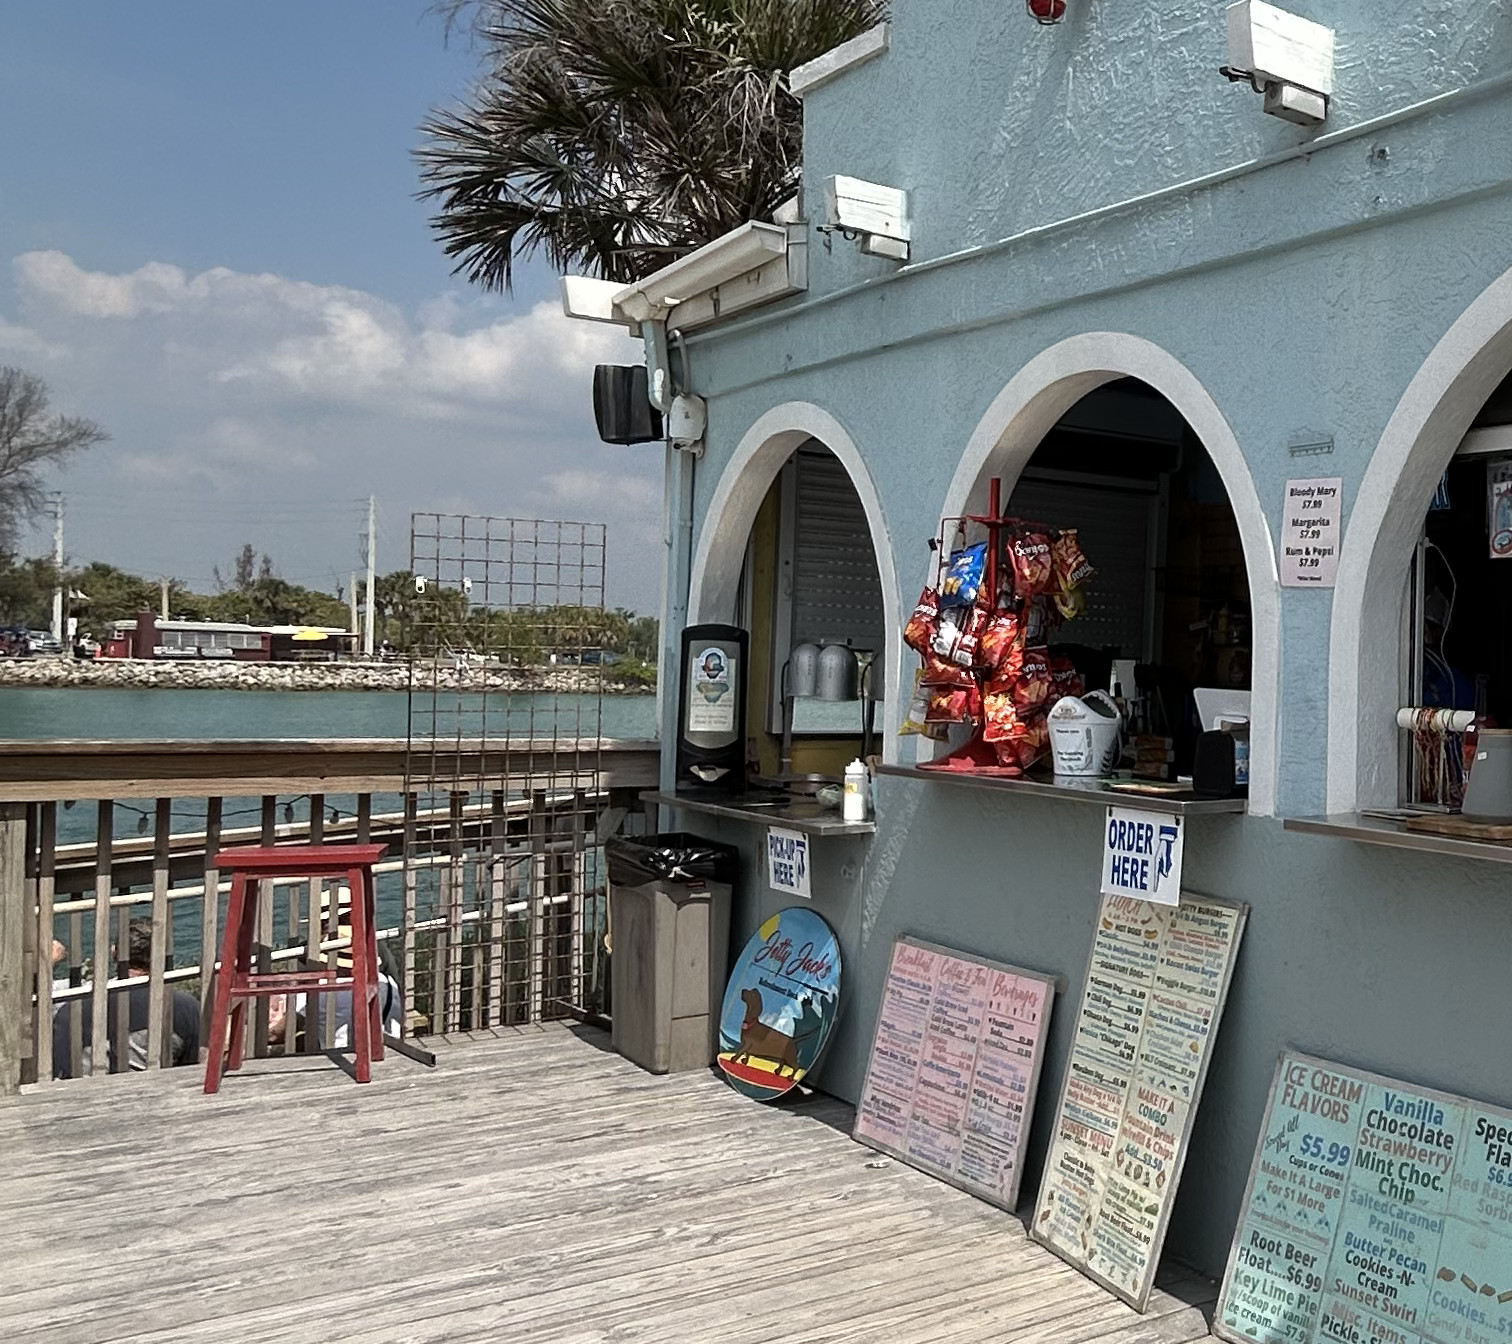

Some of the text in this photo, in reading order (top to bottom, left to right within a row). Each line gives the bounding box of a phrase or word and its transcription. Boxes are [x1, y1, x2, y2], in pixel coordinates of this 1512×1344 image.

[1290, 487, 1336, 498] Bloody Mary
[1302, 500, 1322, 509] $7.99
[1291, 517, 1330, 528] Margarita
[1300, 529, 1320, 539] $7.99
[1286, 546, 1334, 557] Rum & Pepsi
[1299, 558, 1319, 567] $7.99
[1108, 819, 1154, 855] ORDER
[774, 862, 795, 887] HERE
[1110, 854, 1149, 891] HERE
[754, 930, 832, 982] Jetty Jack's
[1284, 1061, 1363, 1104] ICE CREAM
[1137, 1087, 1175, 1114] MAKE IT A
[1138, 1103, 1167, 1126] COMBO
[1281, 1084, 1349, 1124] FLAVORS
[1385, 1092, 1444, 1126] Vanilla
[1366, 1109, 1454, 1150] Chocolate
[1300, 1133, 1350, 1166] $5.99
[1359, 1127, 1453, 1175] Strawberry
[1261, 1160, 1341, 1199] Make It A Large
[1289, 1155, 1344, 1181] Cups or Cones
[1355, 1148, 1444, 1193] Mint Choc.
[1453, 1173, 1479, 1193] Red
[1266, 1180, 1325, 1213] For $1 More
[1378, 1176, 1416, 1205] Chip
[1368, 1214, 1416, 1244] Praline
[1250, 1230, 1317, 1269] Root Beer
[1344, 1231, 1427, 1275] Butter Pecan
[1345, 1249, 1394, 1280] Cookies
[1234, 1267, 1318, 1316] Key Lime Pie
[1357, 1271, 1398, 1299] Cream
[1271, 1304, 1282, 1316] of
[1334, 1278, 1418, 1325] Sunset Swirl
[1320, 1313, 1359, 1344] Pickle
